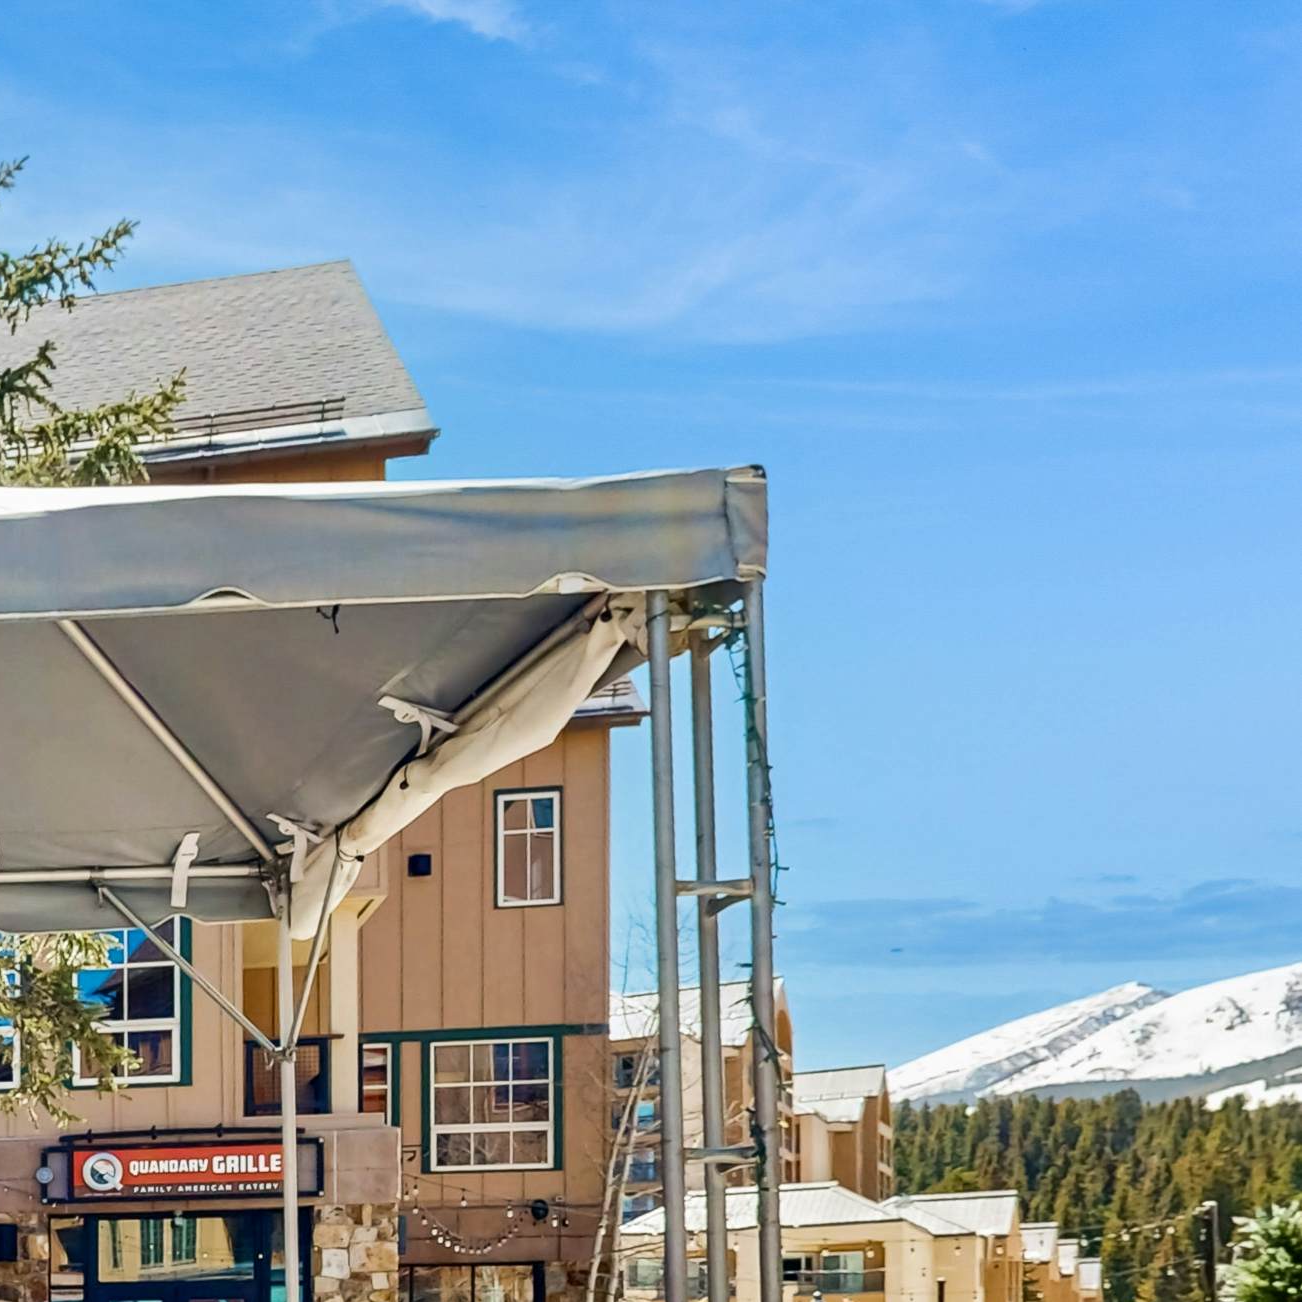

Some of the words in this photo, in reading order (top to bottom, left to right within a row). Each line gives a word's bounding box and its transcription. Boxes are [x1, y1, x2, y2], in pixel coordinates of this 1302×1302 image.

[129, 1158, 208, 1176] QUANDARY
[212, 1154, 282, 1174] GRILLE
[133, 1184, 172, 1193] FAMILY
[177, 1184, 232, 1192] AMERICAN
[238, 1182, 280, 1191] EATERY
